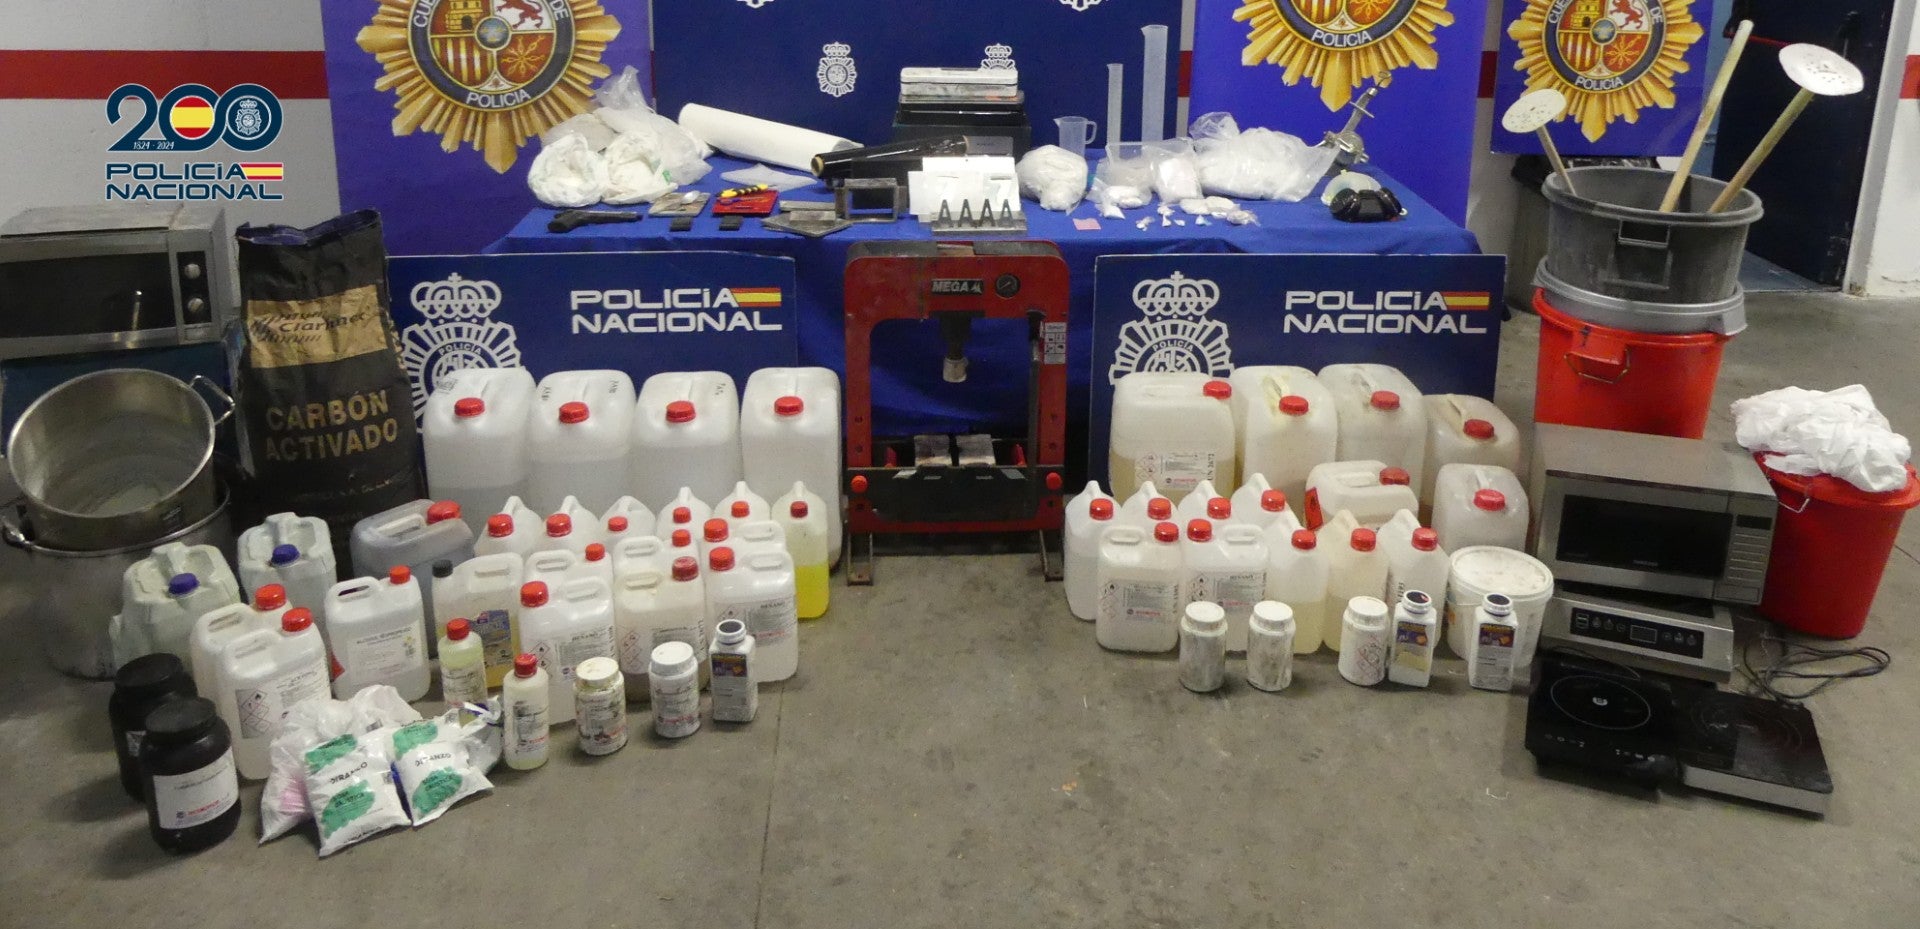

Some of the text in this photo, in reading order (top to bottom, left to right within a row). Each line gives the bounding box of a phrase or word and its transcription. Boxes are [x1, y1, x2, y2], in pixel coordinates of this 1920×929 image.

[1650, 6, 1664, 25] DE
[932, 280, 969, 293] MEGA
[571, 310, 783, 334] NACIONAL
[1283, 313, 1488, 334] NACIONAL
[265, 389, 390, 431] CARBÓN
[265, 417, 398, 461] ACTIVADO
